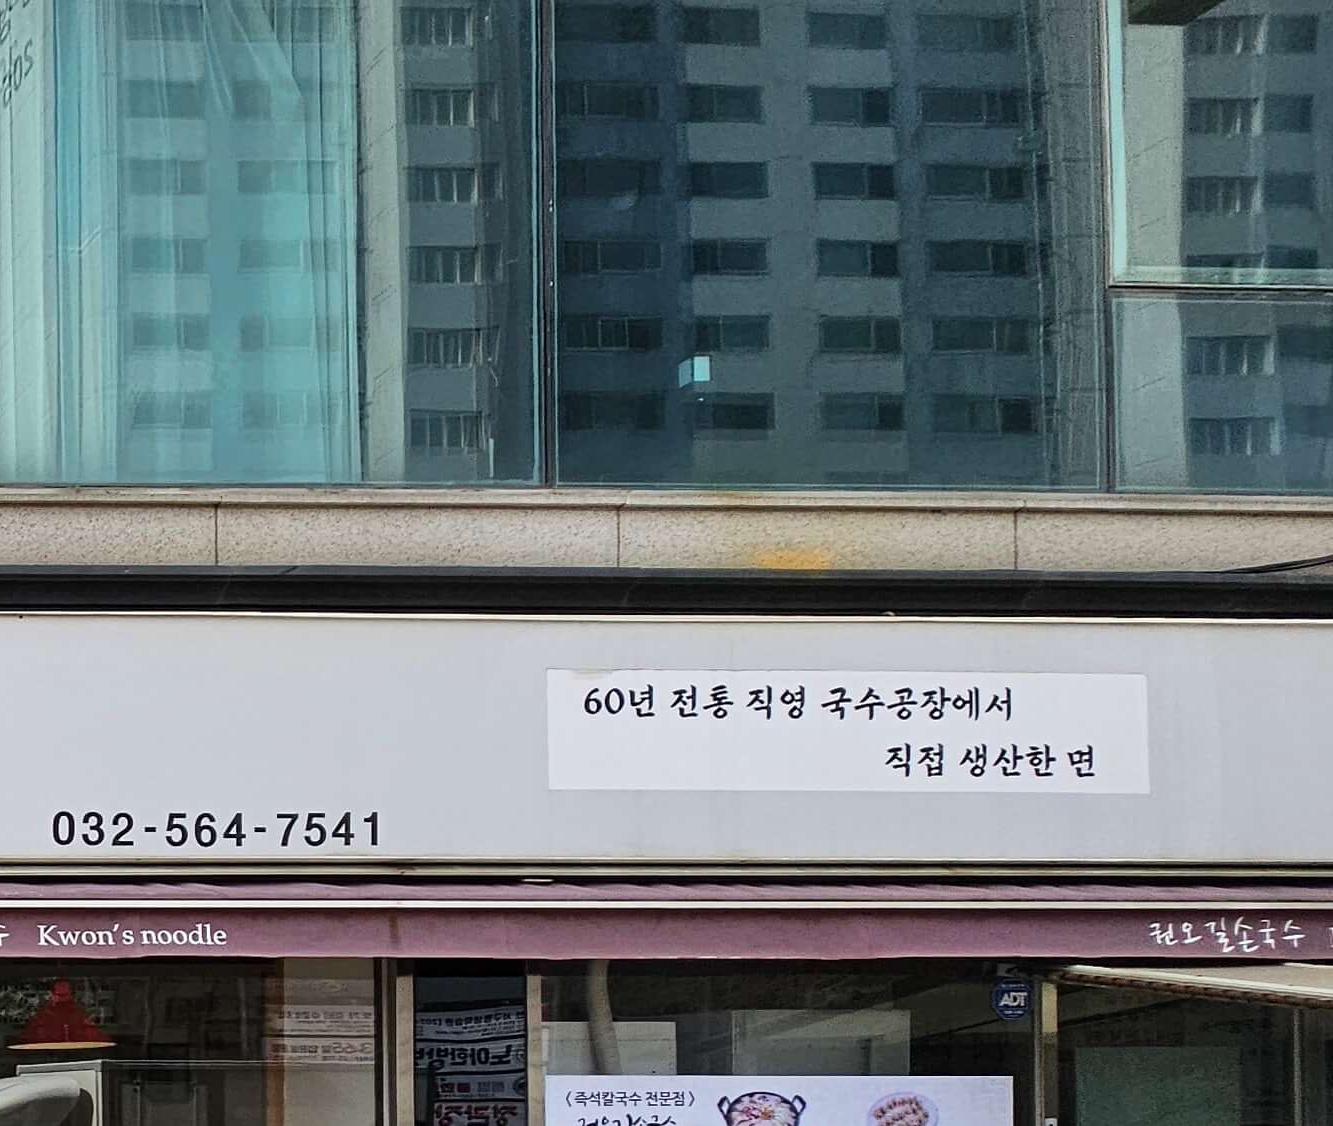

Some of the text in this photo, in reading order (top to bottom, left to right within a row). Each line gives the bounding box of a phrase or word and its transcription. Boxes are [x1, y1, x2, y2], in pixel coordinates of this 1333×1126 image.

[583, 685, 1014, 723] 60년 전통 직영 국수공장에서
[884, 743, 1097, 780] 직접 생산한 면
[51, 811, 382, 848] 032-564-7541
[37, 922, 135, 947] Kwon's
[141, 923, 227, 947] noodle
[1148, 917, 1306, 953] 권오길손국수
[998, 991, 1028, 1006] ADT
[574, 1091, 685, 1107] 즉석칼국수 전문점
